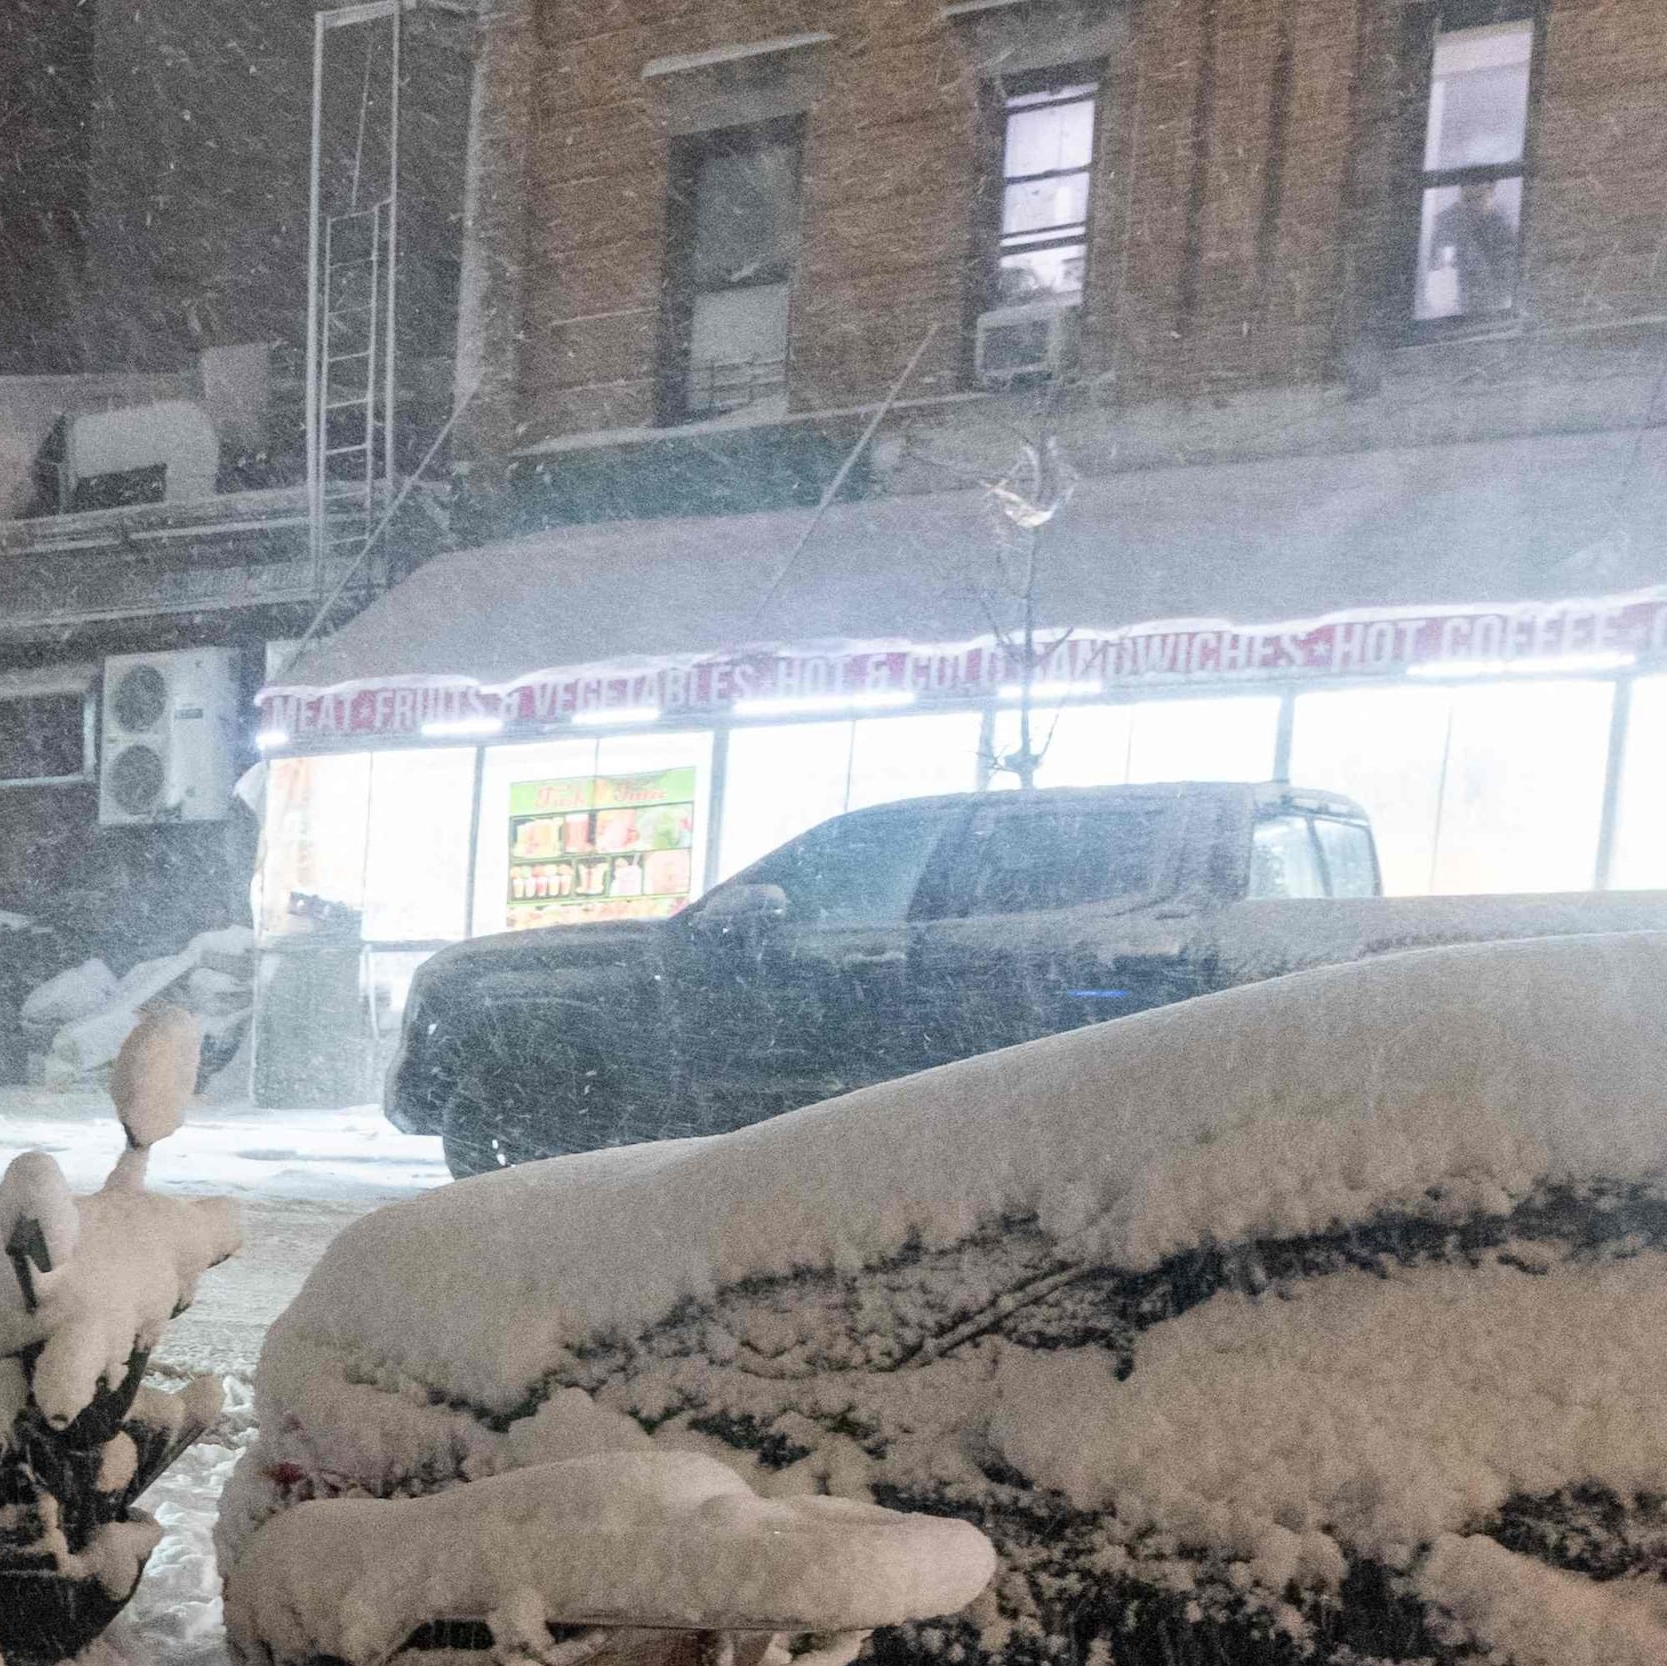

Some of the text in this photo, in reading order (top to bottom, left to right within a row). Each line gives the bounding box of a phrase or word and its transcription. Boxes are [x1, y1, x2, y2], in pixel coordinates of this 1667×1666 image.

[271, 692, 361, 734] MEAT
[373, 684, 486, 729] FRUITS
[531, 663, 755, 719] VEGETABLES
[775, 652, 848, 701] HOT
[866, 654, 889, 692] &
[906, 645, 1007, 691] COLD
[1333, 618, 1426, 672] HOT
[1441, 607, 1621, 663] COFFEE
